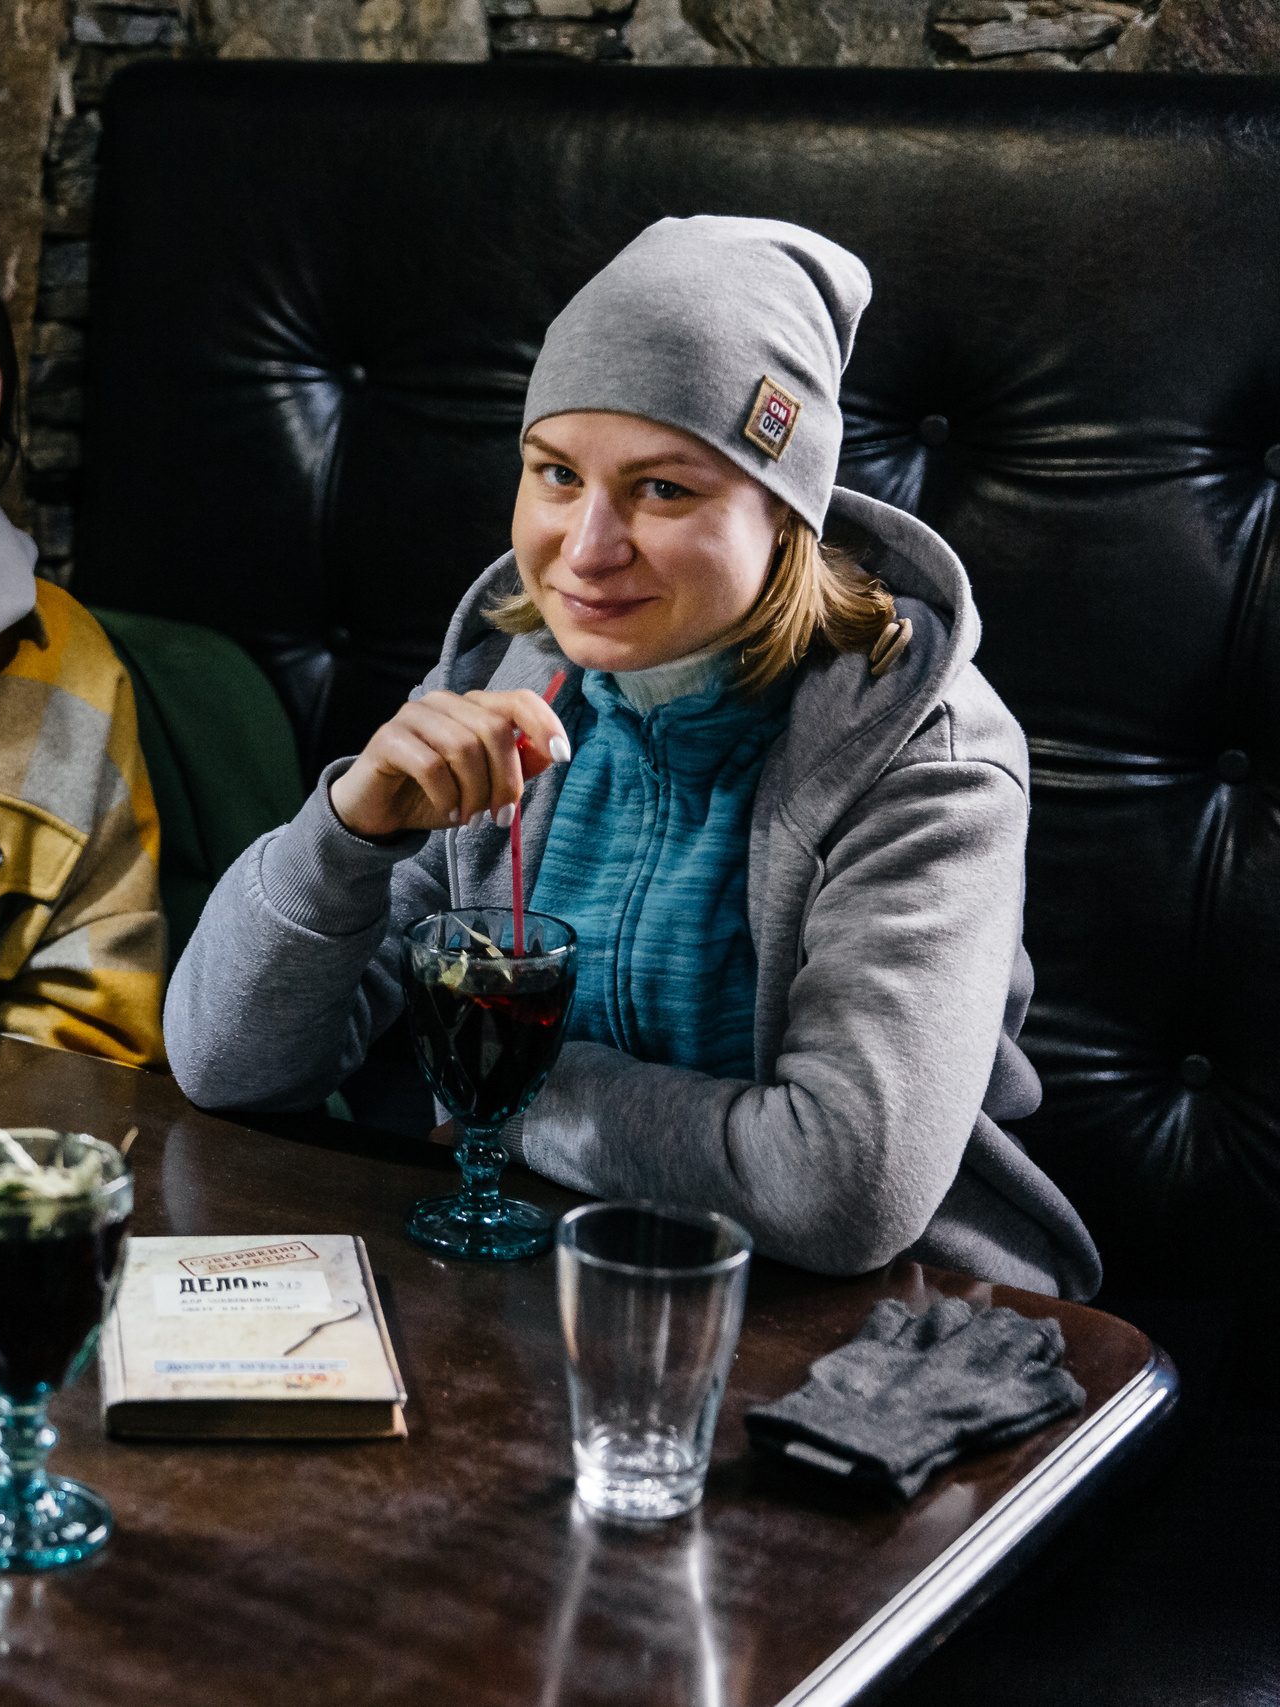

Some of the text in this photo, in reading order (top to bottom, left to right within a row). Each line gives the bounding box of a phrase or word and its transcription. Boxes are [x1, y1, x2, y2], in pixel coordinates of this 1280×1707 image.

[770, 401, 787, 421] ON
[762, 415, 784, 438] OFF
[179, 1277, 249, 1295] ДЕЛО
